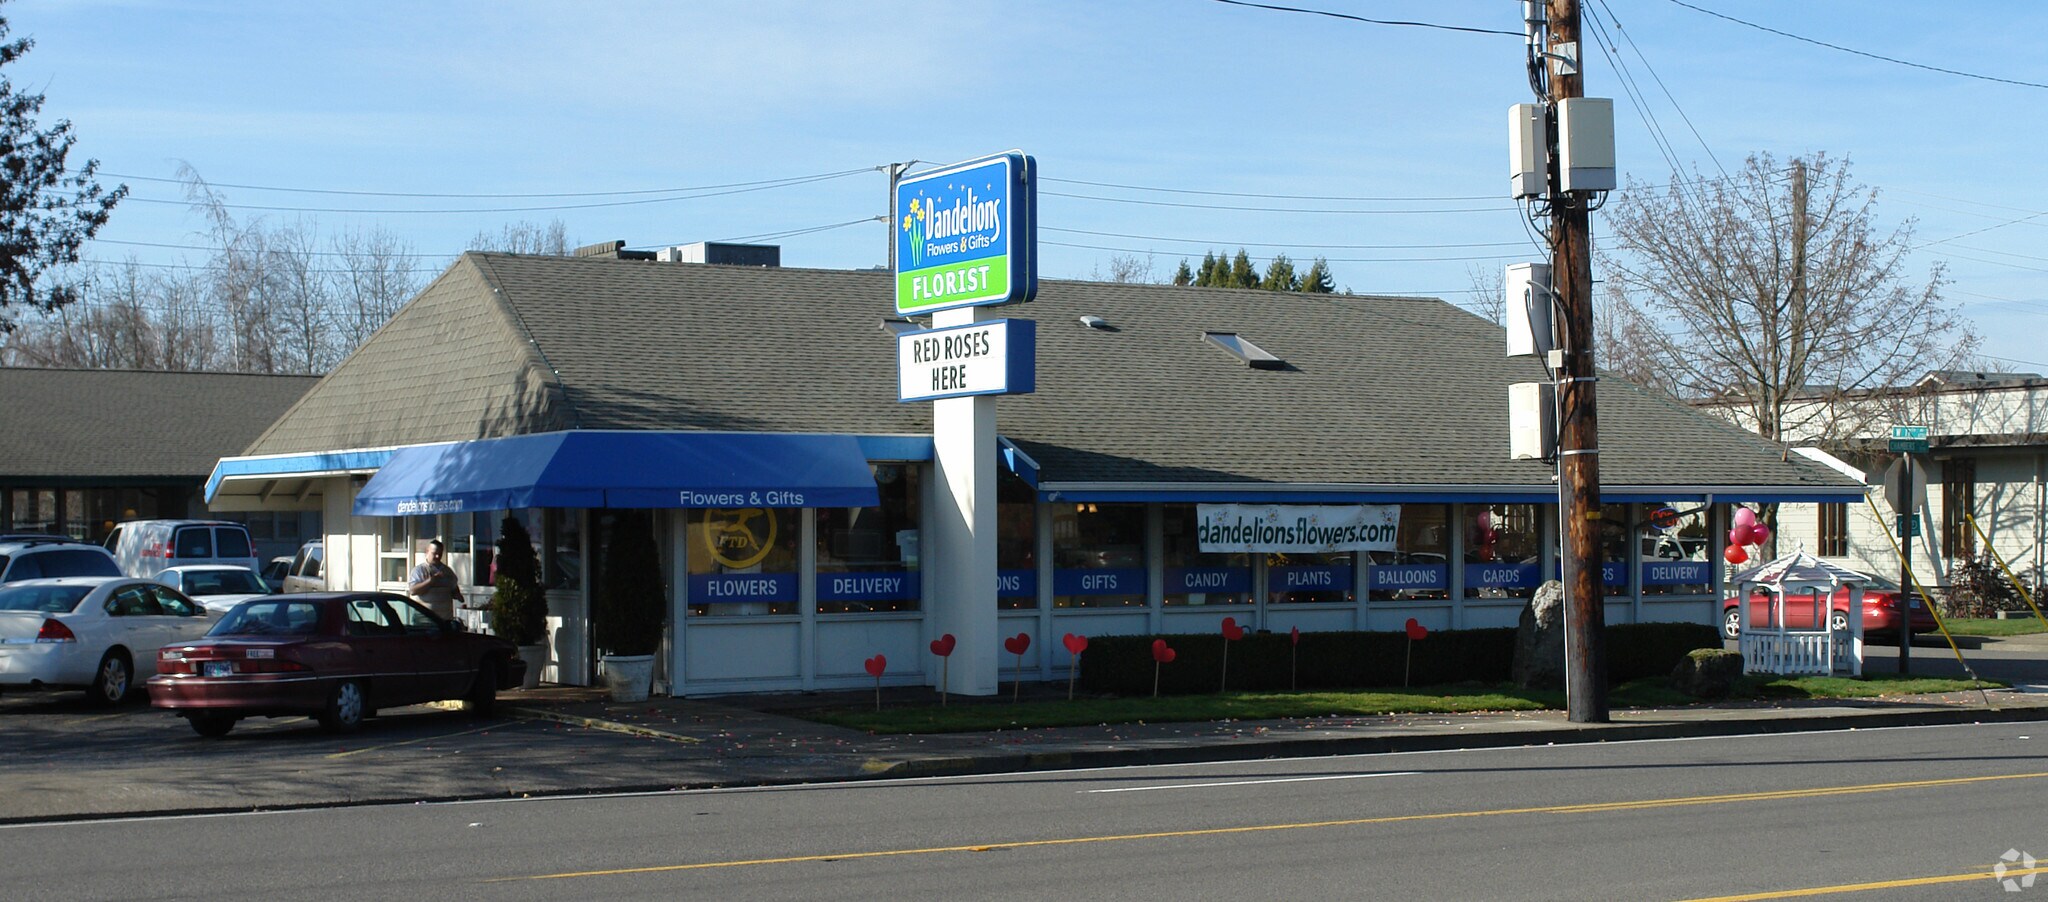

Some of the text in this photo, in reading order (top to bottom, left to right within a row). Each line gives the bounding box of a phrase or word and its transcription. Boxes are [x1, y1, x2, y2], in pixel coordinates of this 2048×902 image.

[925, 187, 1001, 243] Dandelions
[927, 235, 990, 257] Flowers & Gifts
[913, 265, 990, 300] FLORIST
[914, 331, 990, 364] RED ROSES
[932, 364, 967, 391] HERE
[680, 491, 804, 505] Flowers & Gifts
[397, 499, 463, 514] dandelonsloers.com
[1199, 516, 1396, 545] dandelionsflowers.com
[718, 536, 749, 549] FTD
[1185, 572, 1228, 588] CANDY
[1287, 570, 1331, 586] PLANTS
[1378, 569, 1437, 584] BALLOONS
[1483, 569, 1520, 583] CARDS
[1652, 566, 1699, 581] DELIVERY
[708, 579, 777, 596] FLOWERS
[834, 578, 901, 594] DELIVERY
[1082, 574, 1117, 590] GIFTS
